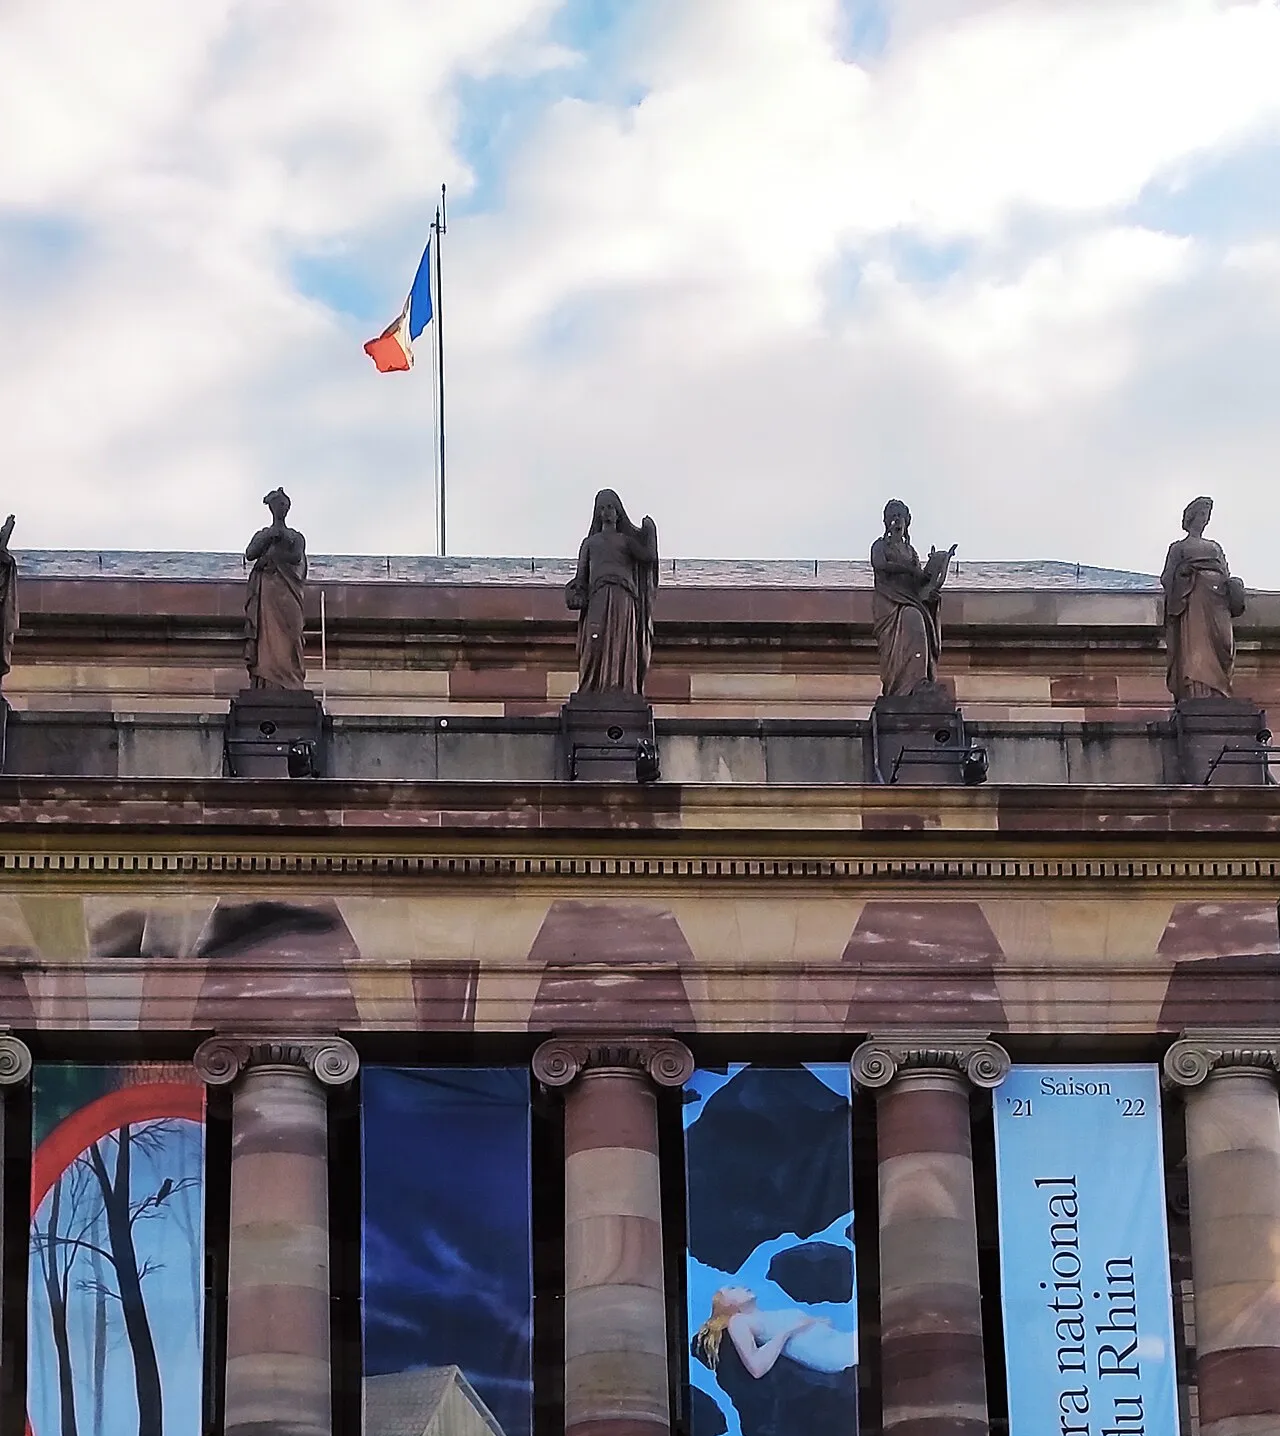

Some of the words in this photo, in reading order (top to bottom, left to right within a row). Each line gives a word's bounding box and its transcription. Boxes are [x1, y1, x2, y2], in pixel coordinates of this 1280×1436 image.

[1040, 1077, 1110, 1095] Saison
[1035, 1177, 1086, 1373] national
[1093, 1256, 1140, 1380] Rhin
